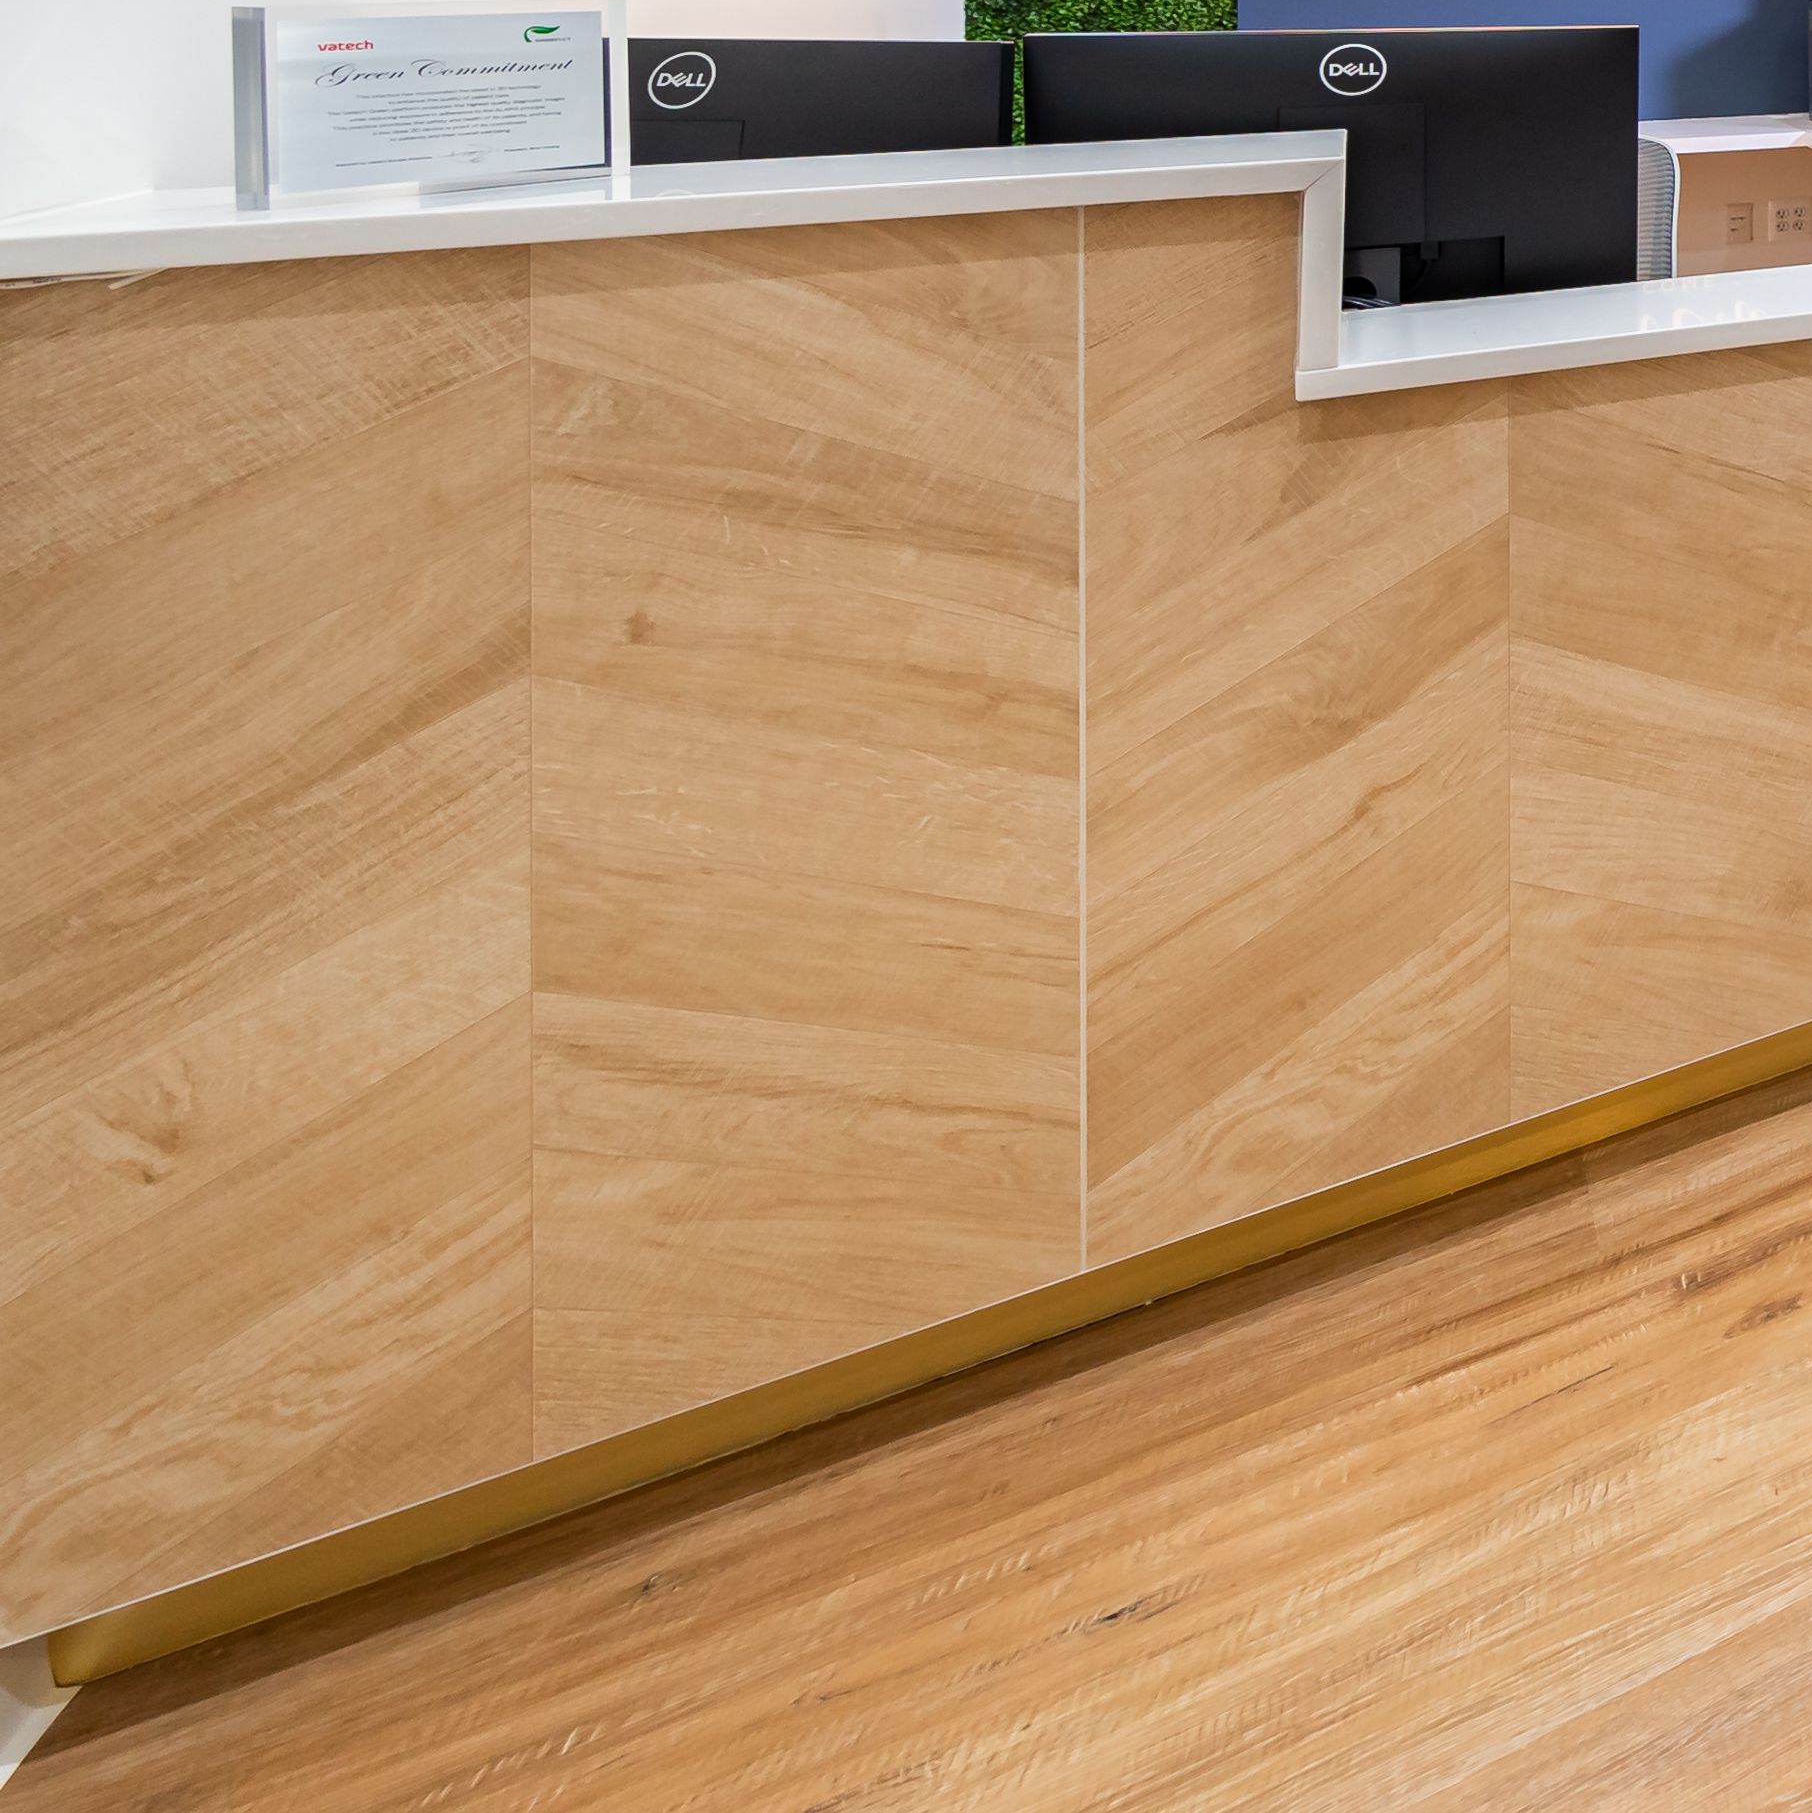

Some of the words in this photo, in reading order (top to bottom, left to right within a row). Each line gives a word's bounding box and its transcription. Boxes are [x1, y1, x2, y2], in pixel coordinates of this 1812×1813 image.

[317, 39, 374, 53] vatech
[314, 61, 405, 87] Green
[410, 58, 574, 78] Commitment
[1328, 62, 1380, 77] DELL
[656, 72, 707, 88] DELL
